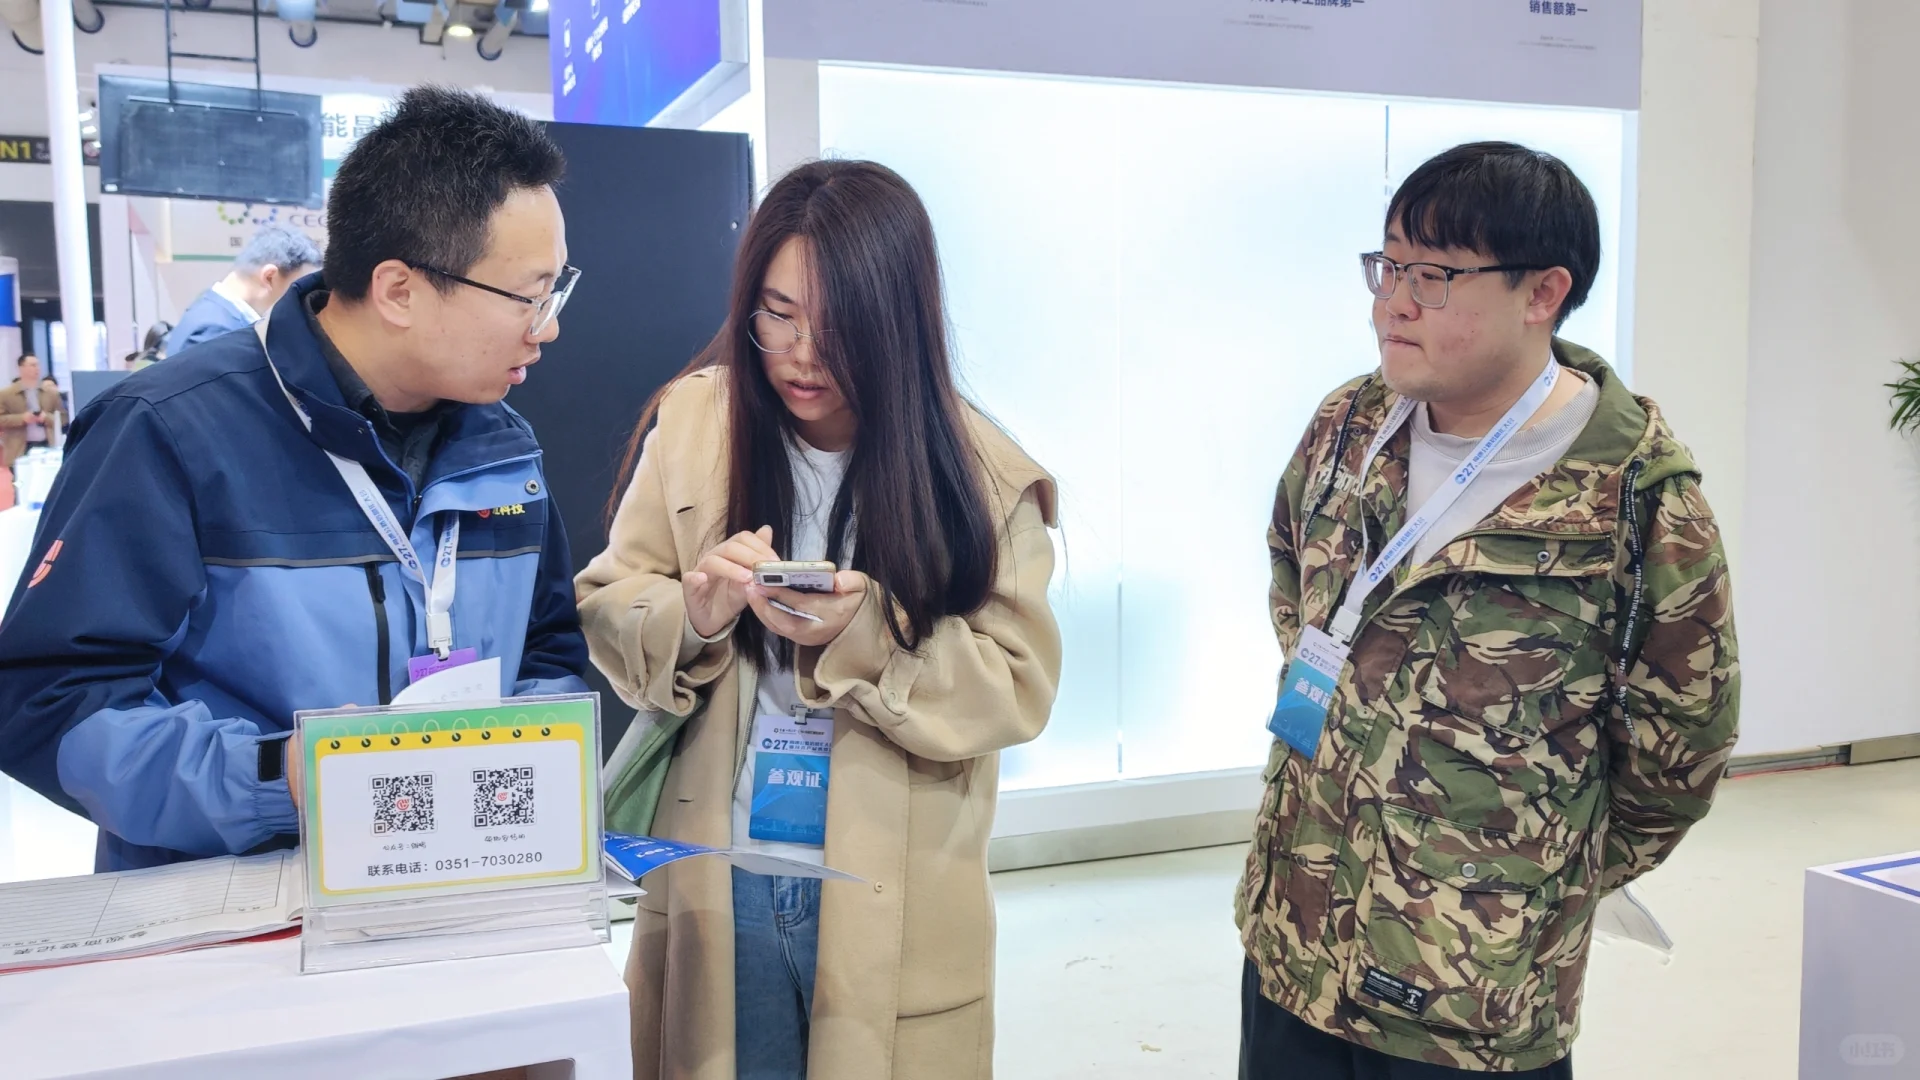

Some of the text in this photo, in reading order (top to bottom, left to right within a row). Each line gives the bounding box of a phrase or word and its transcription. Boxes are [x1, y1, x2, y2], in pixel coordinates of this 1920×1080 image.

[1529, 0, 1588, 16] 销售额第一
[0, 140, 31, 159] N1
[767, 767, 822, 788] 参观证
